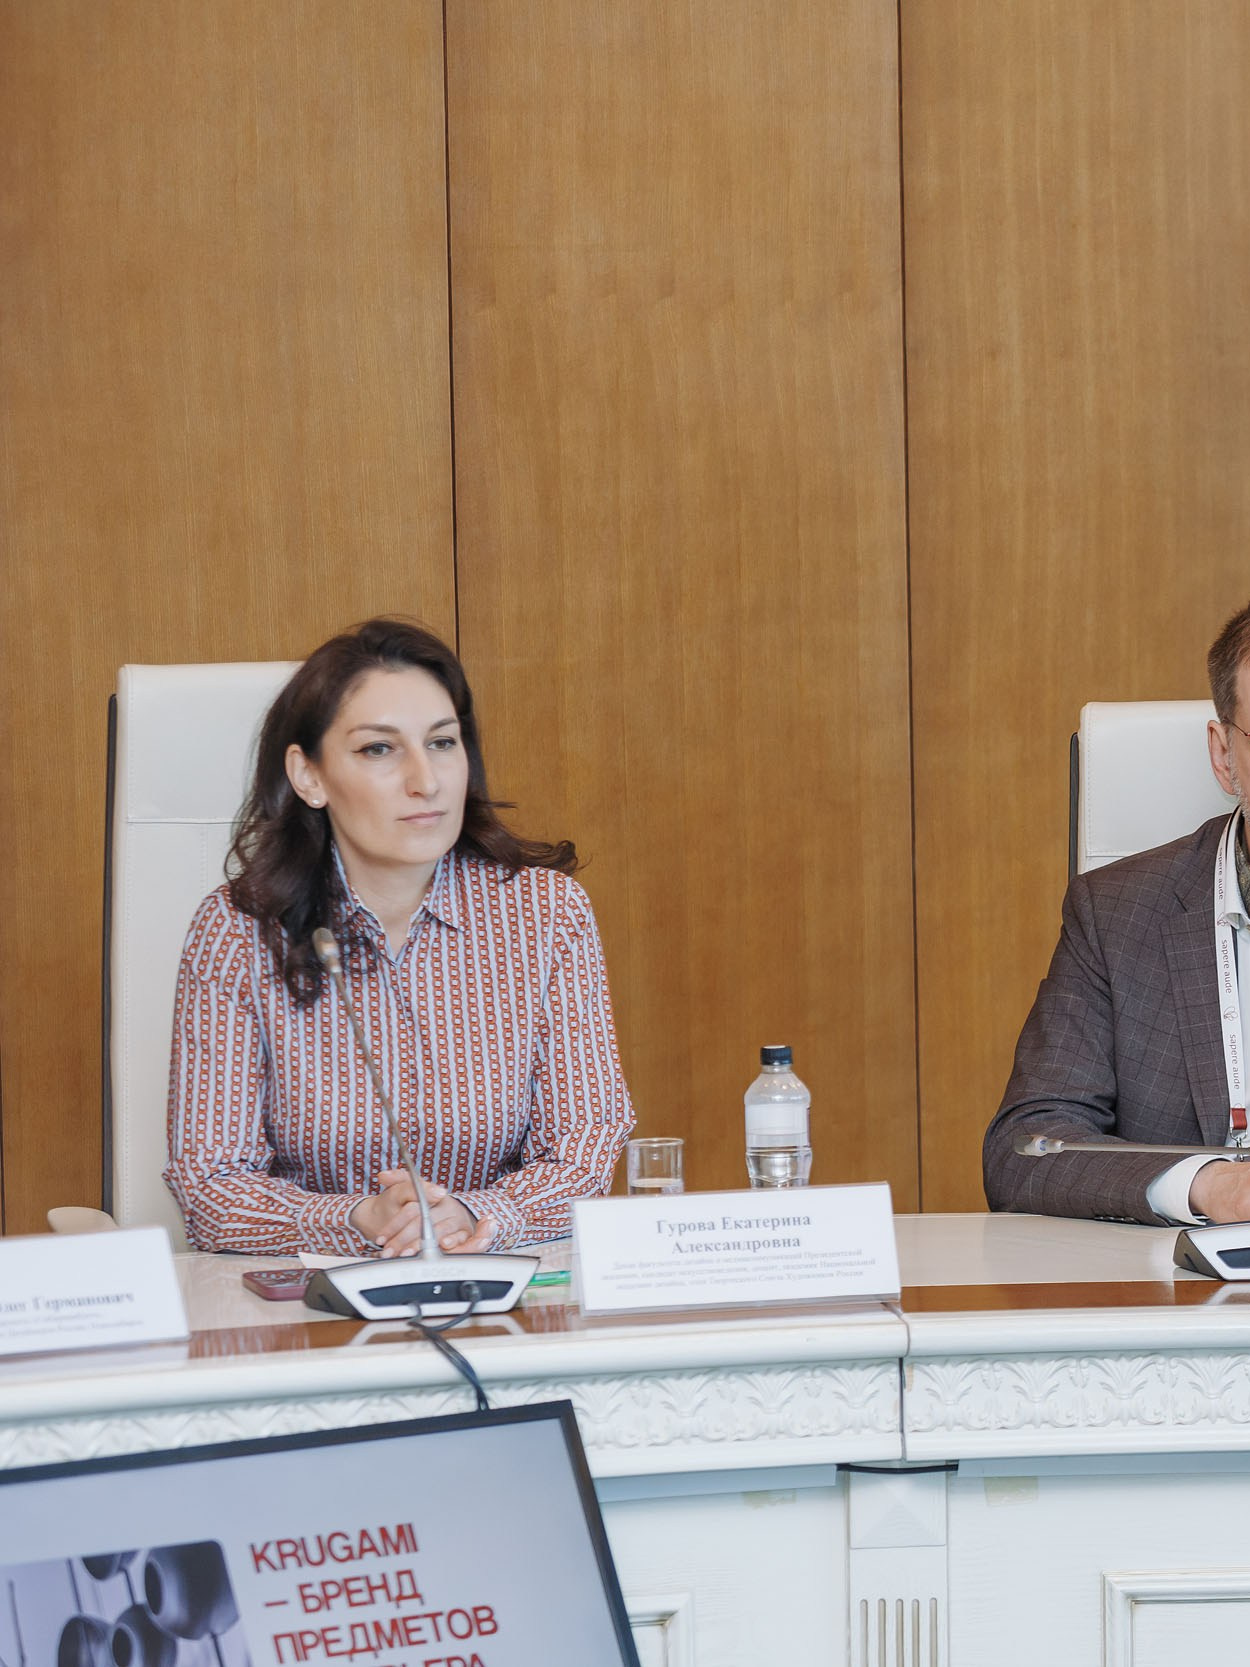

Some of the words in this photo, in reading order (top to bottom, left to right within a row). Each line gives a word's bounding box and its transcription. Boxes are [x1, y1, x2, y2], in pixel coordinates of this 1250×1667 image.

[1221, 939, 1231, 970] sapere
[1224, 971, 1233, 994] aude
[1229, 1034, 1240, 1067] sapere
[1232, 1068, 1242, 1090] aude
[656, 1219, 716, 1237] Гурова
[721, 1215, 811, 1231] Екатерина
[672, 1237, 801, 1254] Александровна
[249, 1523, 420, 1573] KRUGAMI
[297, 1569, 425, 1614] БРЕНД
[273, 1605, 499, 1664] ПРЕДМЕТОВ
